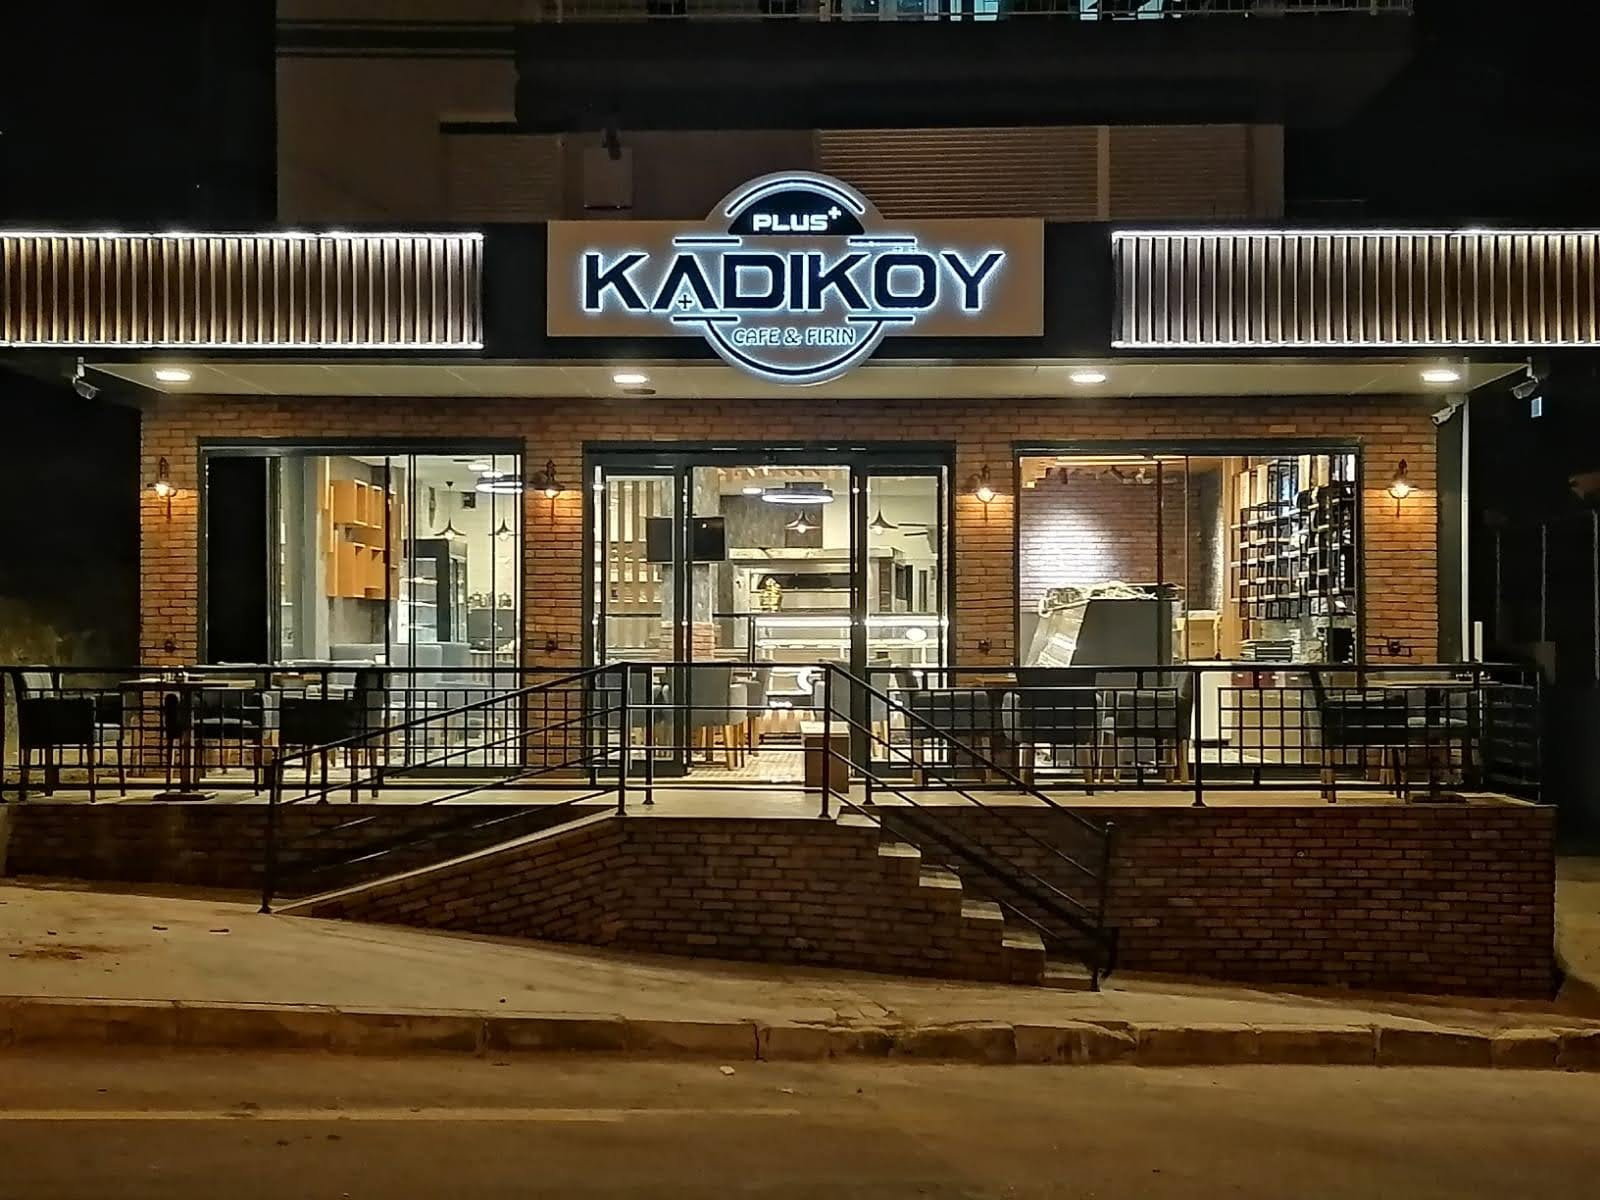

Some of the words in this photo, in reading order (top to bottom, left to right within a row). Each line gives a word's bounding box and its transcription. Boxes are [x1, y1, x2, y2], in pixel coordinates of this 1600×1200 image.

[733, 327, 780, 345] CAFE
[784, 327, 802, 345] &
[806, 326, 856, 345] FIRIN
